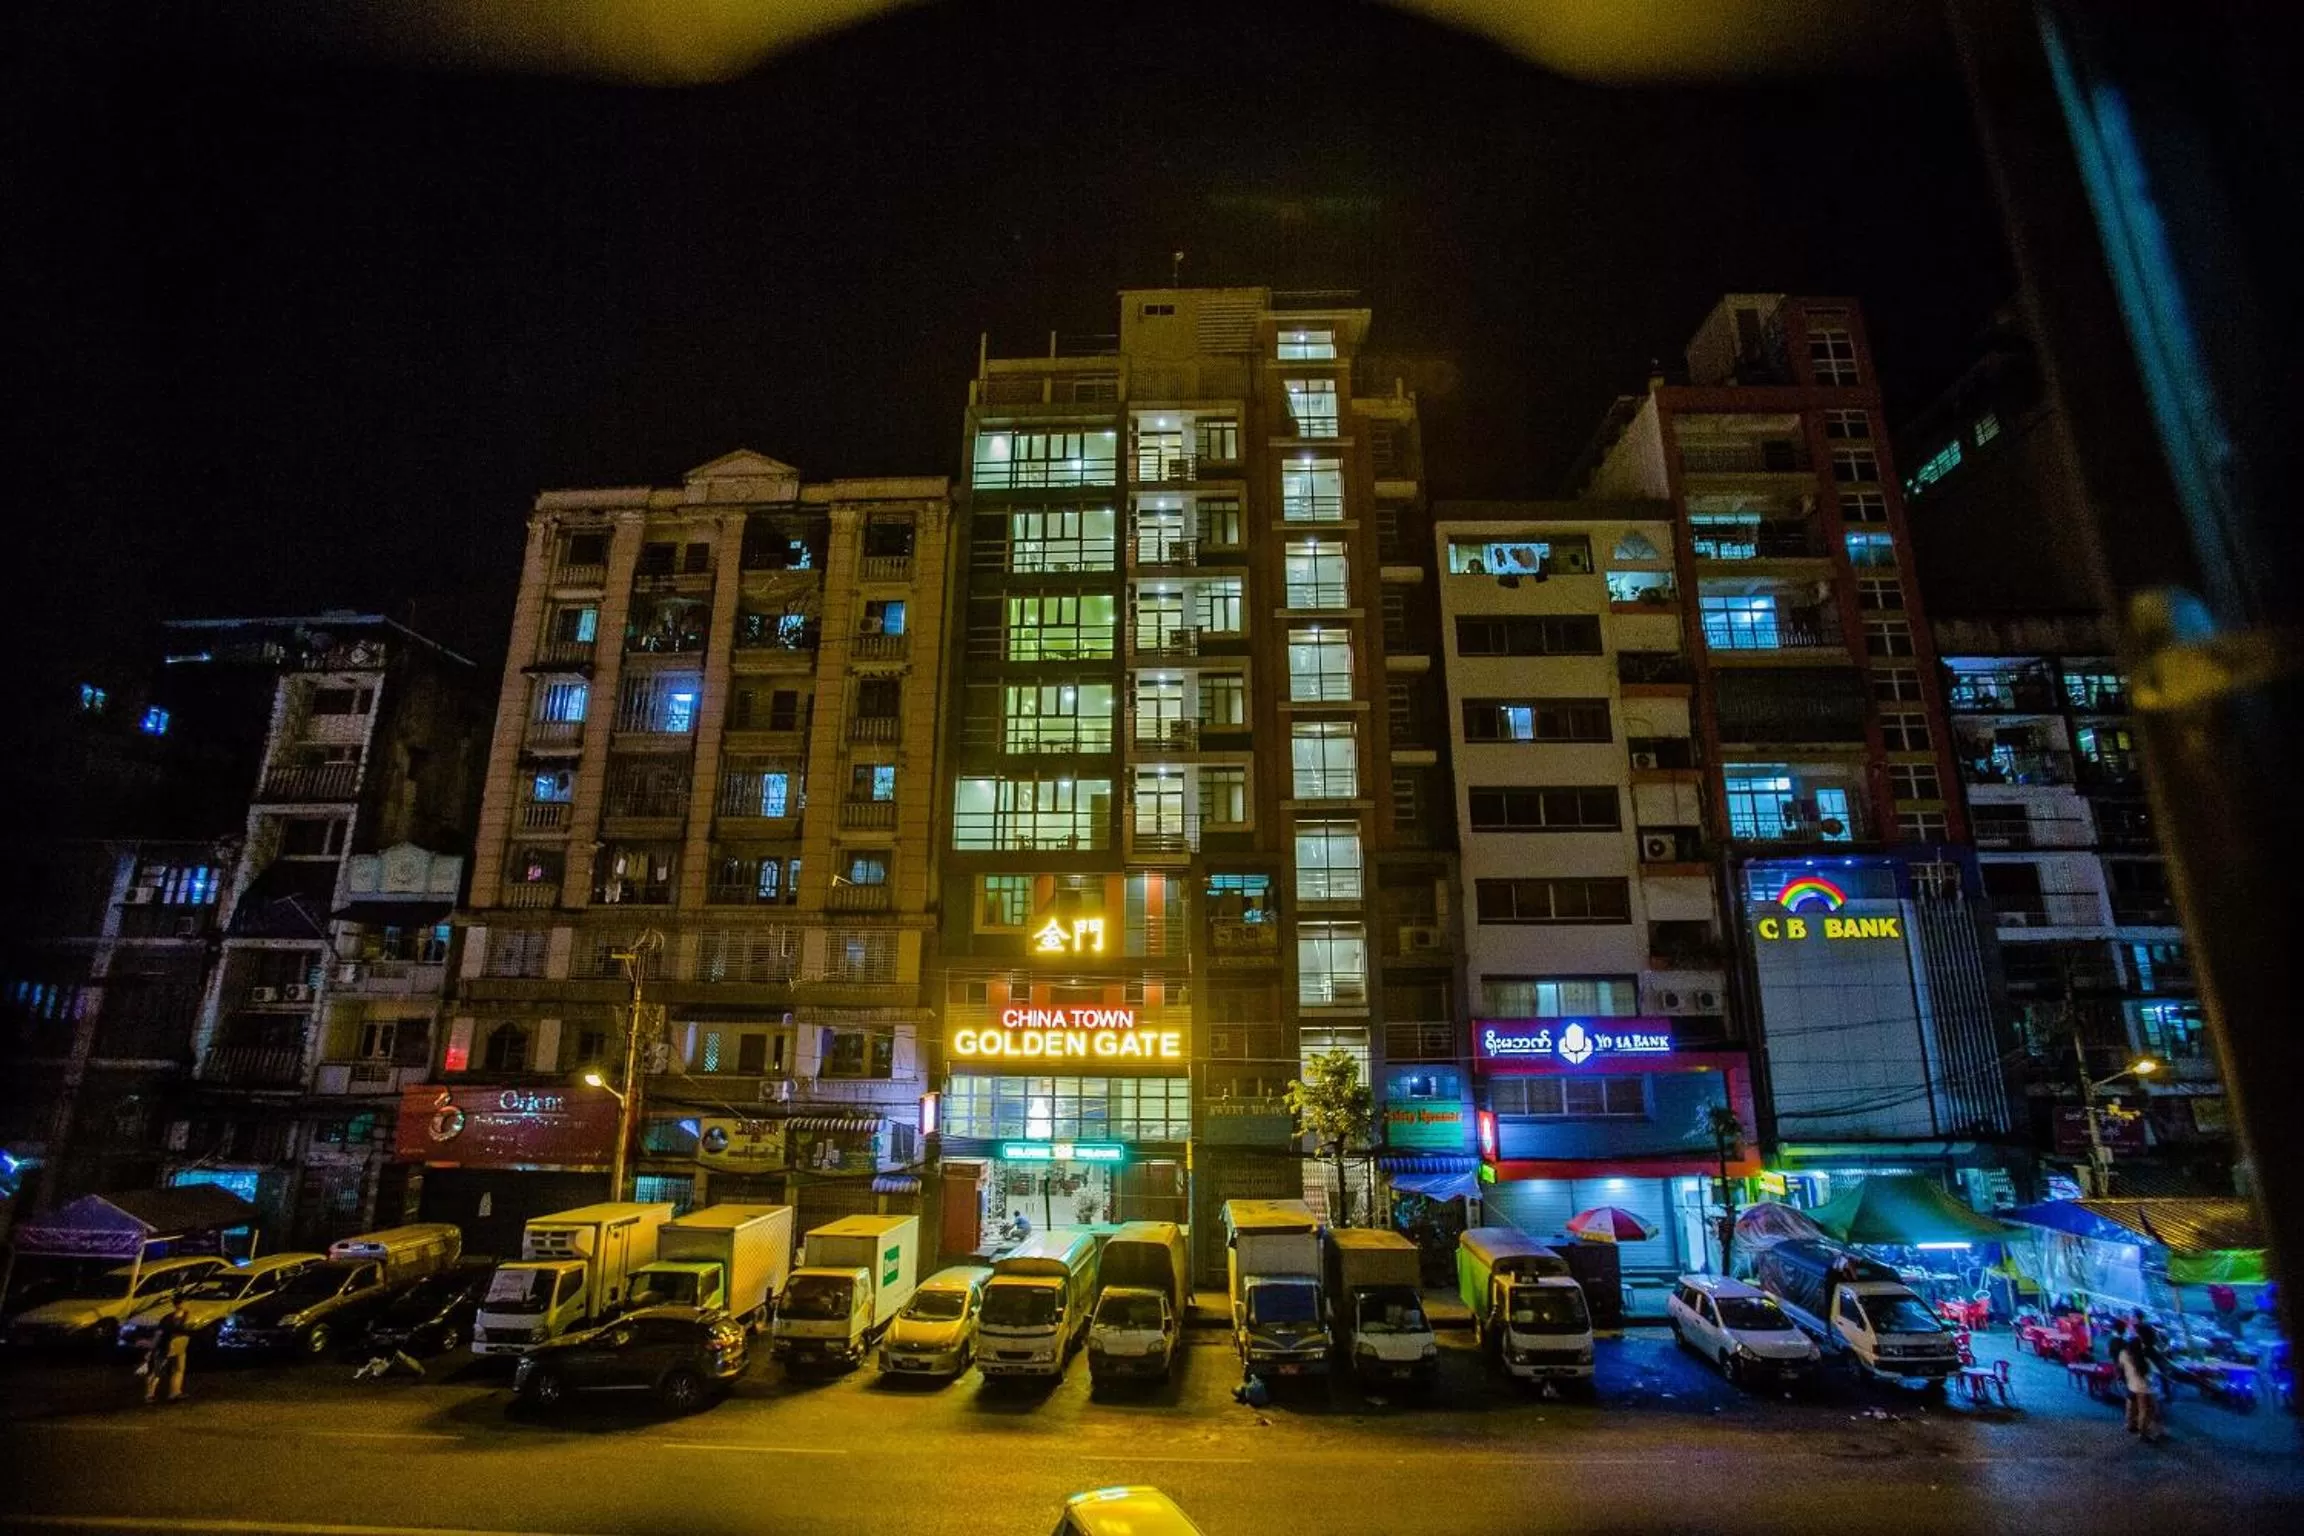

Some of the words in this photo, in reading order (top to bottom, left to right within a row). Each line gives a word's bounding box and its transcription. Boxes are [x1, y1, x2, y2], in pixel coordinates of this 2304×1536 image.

[1033, 917, 1106, 953] 金門
[1824, 917, 1900, 939] BANK
[1002, 1009, 1066, 1028] CHINA
[1070, 1009, 1134, 1028] TOWN
[954, 1030, 1087, 1057] GOLDEN
[1094, 1031, 1182, 1057] GATE
[1632, 1034, 1670, 1048] BANK
